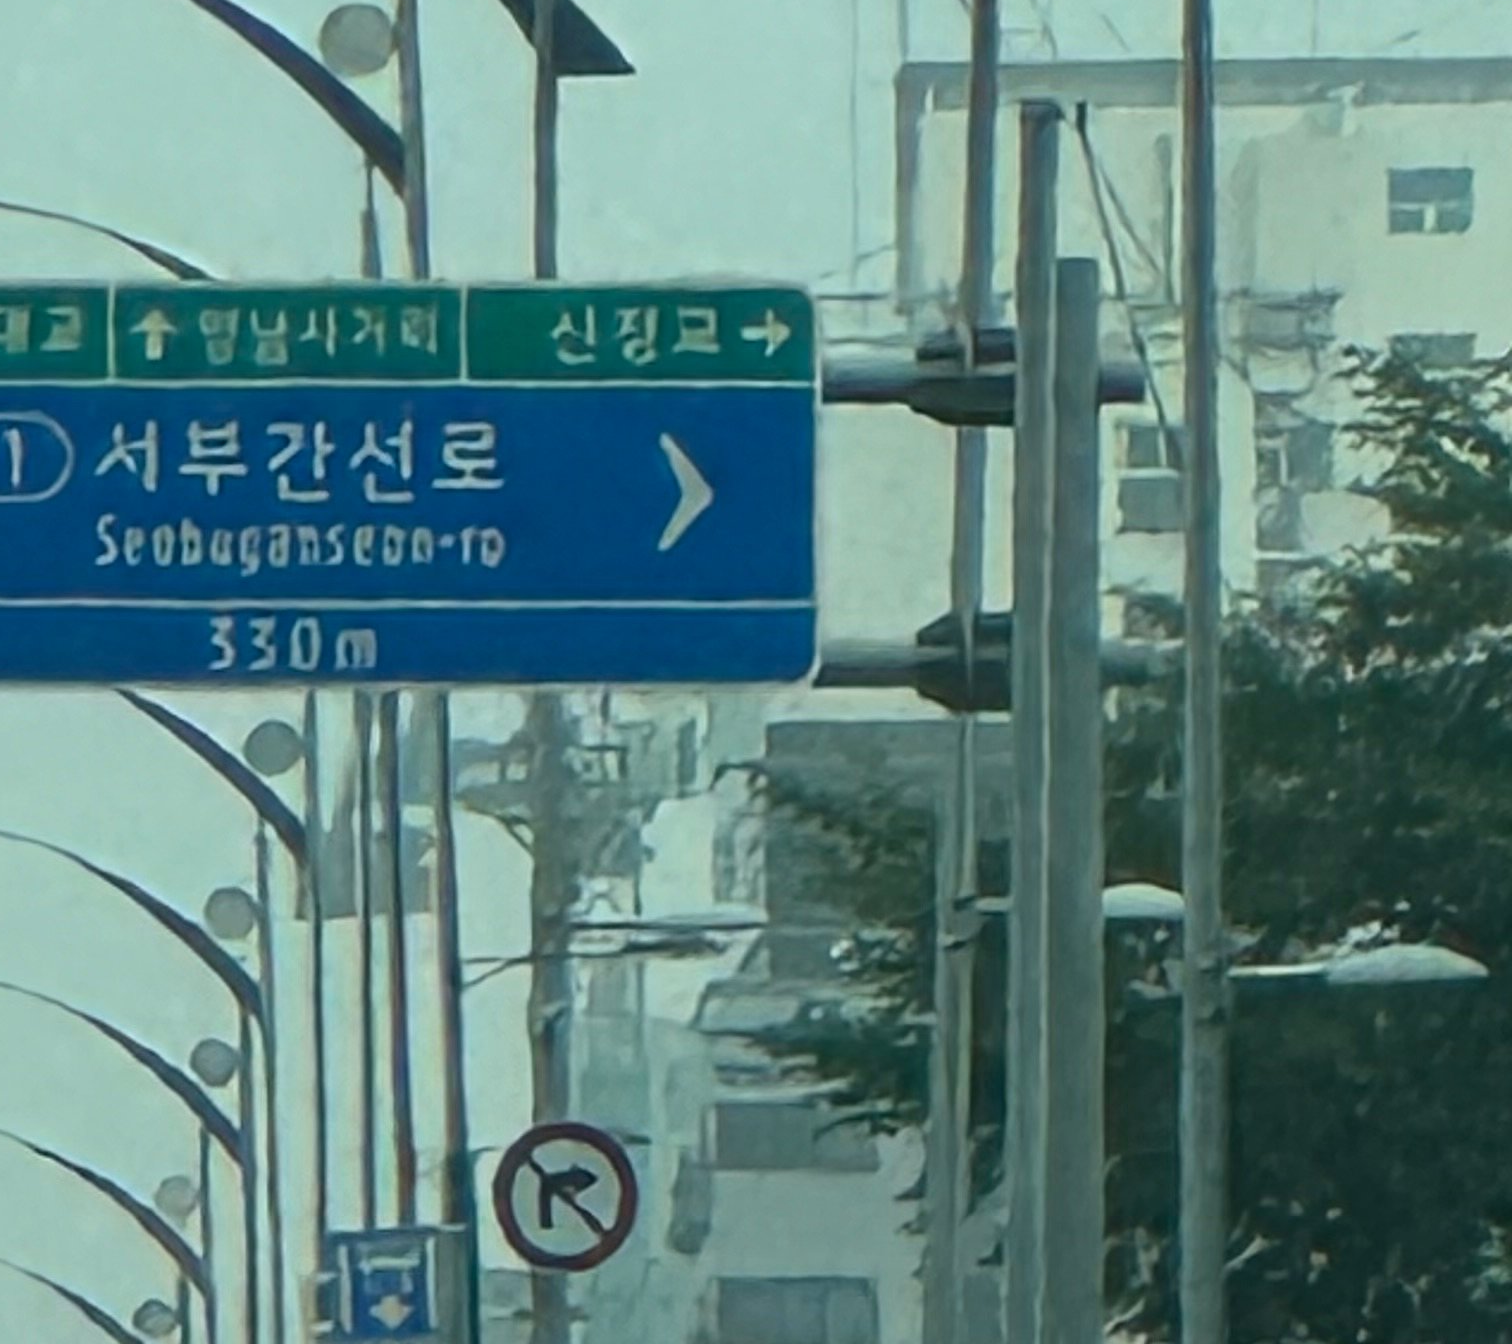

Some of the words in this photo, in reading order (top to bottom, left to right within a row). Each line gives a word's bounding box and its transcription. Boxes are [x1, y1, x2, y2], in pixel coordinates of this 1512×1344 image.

[551, 304, 721, 366] 신정교
[94, 419, 505, 504] 서부간선로
[94, 513, 506, 577] Seobuganseon-ro
